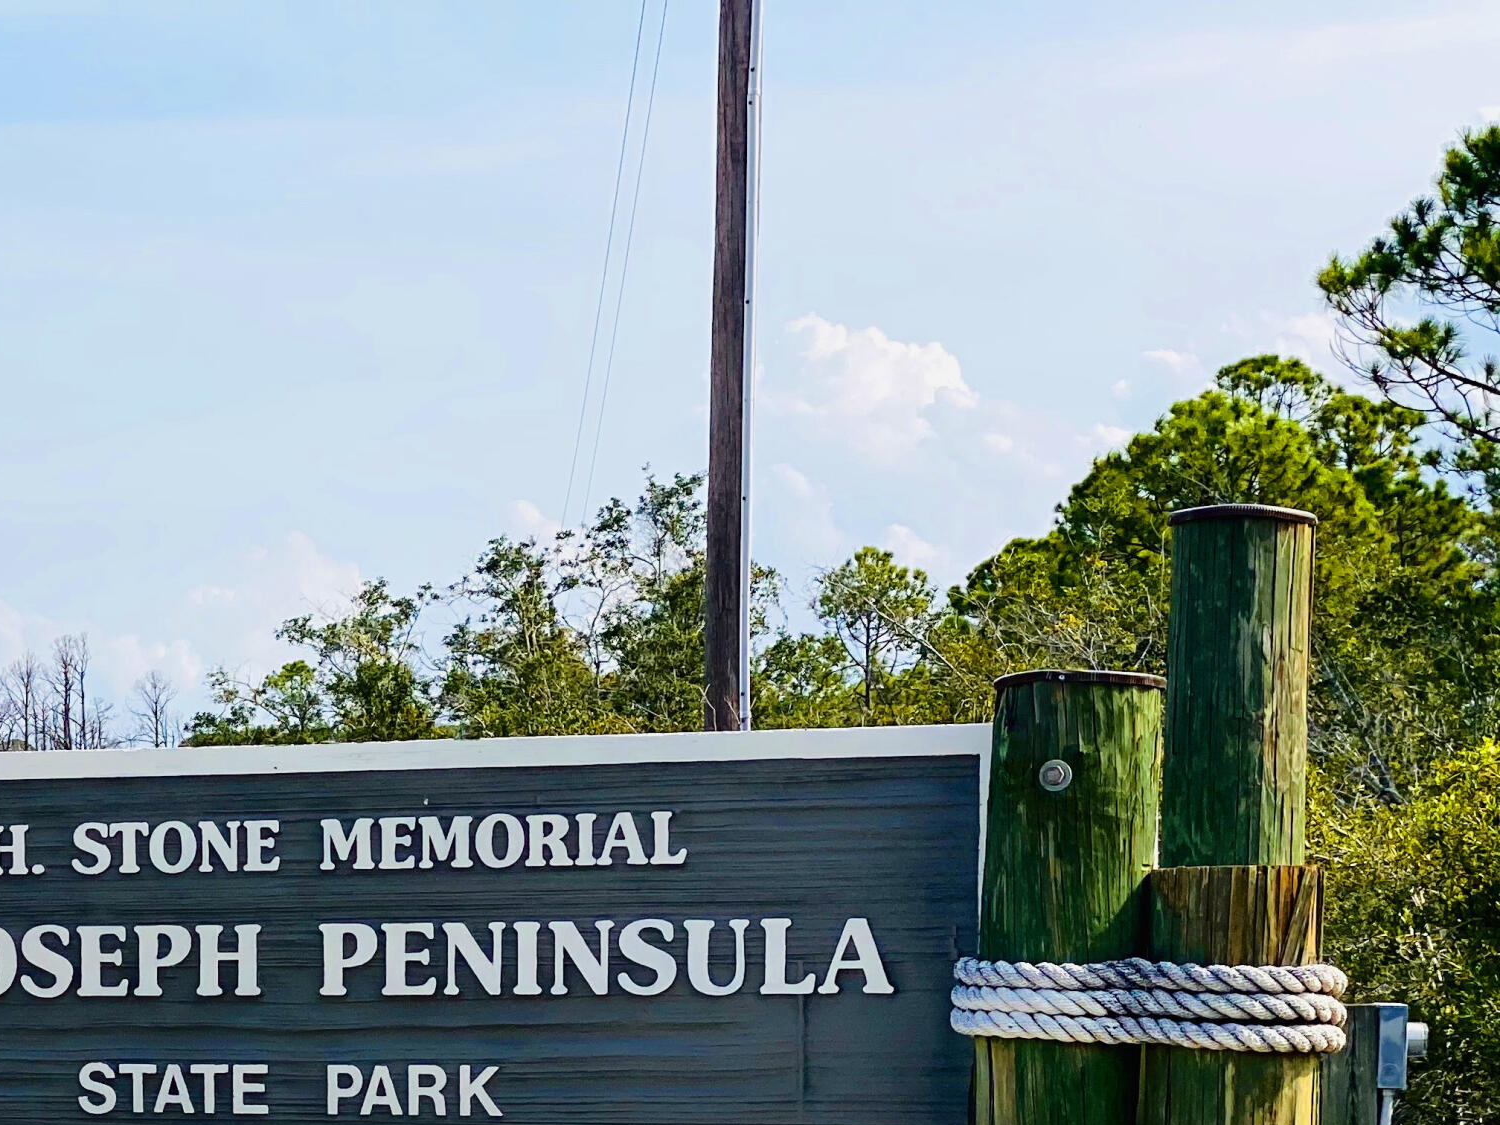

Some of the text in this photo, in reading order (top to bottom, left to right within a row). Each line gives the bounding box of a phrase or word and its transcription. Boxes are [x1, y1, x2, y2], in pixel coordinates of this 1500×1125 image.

[72, 820, 281, 875] STONE
[319, 811, 688, 871] MEMORIAL
[318, 917, 895, 996] PENINSULA
[77, 1061, 504, 1117] STATE PARK
